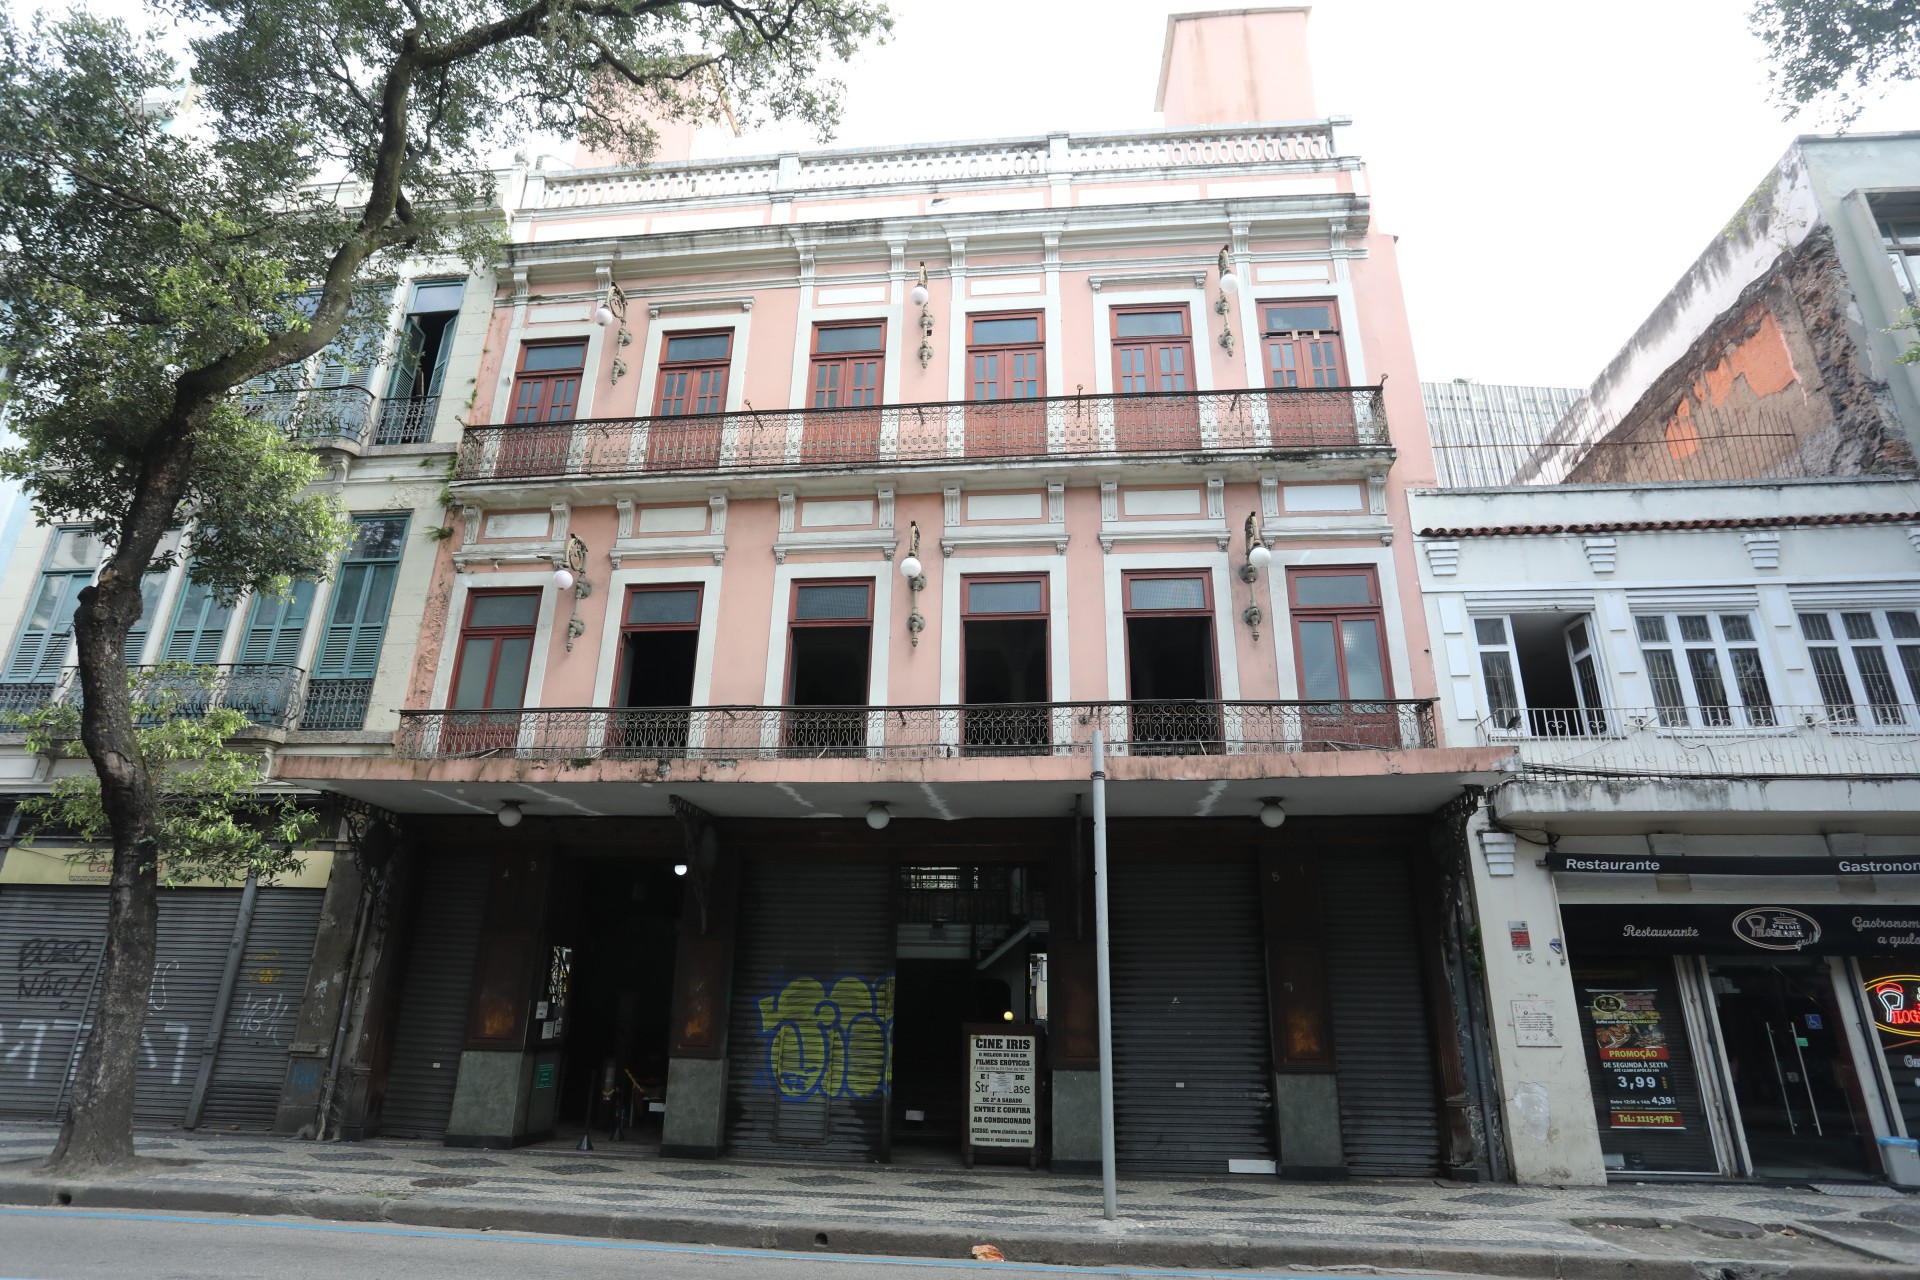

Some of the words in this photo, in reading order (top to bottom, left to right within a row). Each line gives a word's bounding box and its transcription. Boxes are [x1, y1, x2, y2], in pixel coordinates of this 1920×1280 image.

[1565, 858, 1660, 871] Restaurante
[1622, 924, 1700, 937] Restaurante
[1877, 935, 1887, 945] a
[975, 1038, 1003, 1049] CINE
[1006, 1039, 1031, 1050] IRIS
[1609, 1048, 1658, 1059] PROMOÇÃO
[975, 1058, 998, 1066] FILMES
[1617, 1076, 1656, 1090] 3,99
[1651, 1096, 1672, 1106] 4,39
[984, 1116, 1031, 1124] CONDICIONADO
